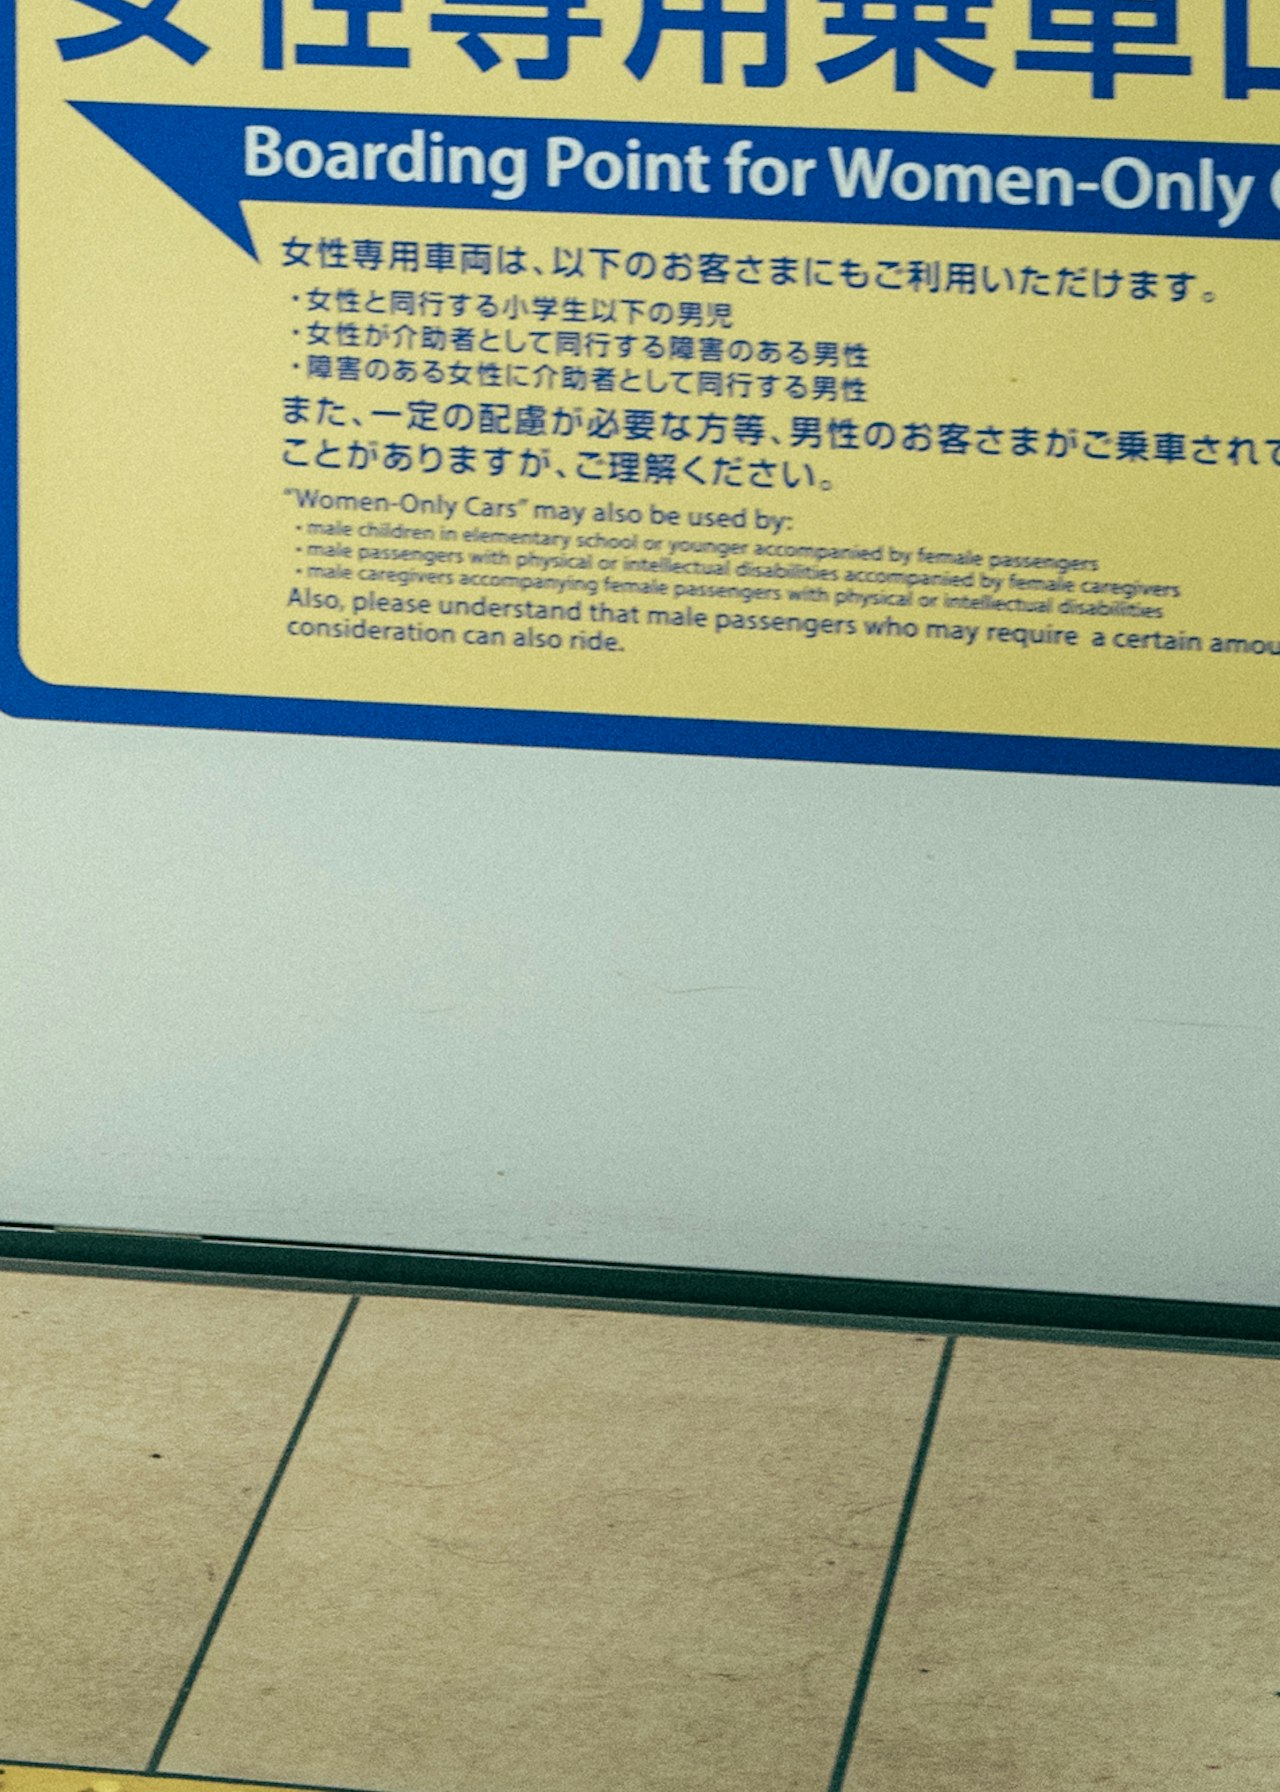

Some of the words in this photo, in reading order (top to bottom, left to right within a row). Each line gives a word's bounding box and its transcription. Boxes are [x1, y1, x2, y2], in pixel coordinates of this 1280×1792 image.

[244, 124, 527, 201] Boarding
[546, 134, 709, 194] Point
[724, 139, 817, 198] for
[827, 146, 1255, 229] Women-Only
[281, 236, 1217, 304] 女性専用車両は、以下のお客さまにもご利用いただけます。
[283, 438, 832, 492] ことがありますが、ご理解ください。
[533, 504, 586, 527] may
[592, 501, 643, 524] also
[649, 504, 681, 526] be
[687, 508, 747, 529] used
[754, 508, 793, 536] by:
[307, 521, 353, 536] male
[358, 522, 435, 540] children
[440, 526, 457, 541] in
[462, 527, 571, 550] elementary
[576, 533, 638, 550] school
[643, 539, 663, 551] or
[668, 540, 749, 559] younger
[753, 544, 884, 564] accompanied
[888, 546, 913, 566] by
[917, 547, 984, 566] female
[989, 555, 1099, 575] passengers
[307, 542, 352, 558] male
[358, 547, 464, 567] passengers
[469, 550, 510, 565] with
[516, 549, 593, 571] physical
[597, 559, 618, 570] or
[623, 555, 730, 576] intellectual
[735, 559, 839, 581] disabilities
[844, 565, 975, 587] accompanied
[980, 568, 1004, 589] by
[1008, 571, 1075, 589] female
[1080, 581, 1181, 601] caregivers
[287, 587, 345, 612] Also,
[352, 590, 432, 620] please
[438, 596, 582, 622] understand
[588, 602, 640, 624] that
[647, 606, 708, 628] male
[715, 605, 857, 638] passengers
[863, 615, 919, 638] who
[926, 623, 980, 645] may
[986, 624, 1079, 648] require
[1091, 631, 1106, 647] a
[1112, 630, 1203, 651] certain
[307, 564, 353, 580] male
[357, 565, 454, 587] caregivers
[459, 570, 599, 594] accompanying
[603, 576, 669, 595] female
[673, 578, 782, 603] passengers
[787, 587, 829, 602] with
[834, 584, 913, 608] physical
[918, 595, 938, 608] or
[943, 594, 1053, 613] intellectual
[1057, 599, 1164, 619] disabilities
[287, 618, 456, 643] consideration
[463, 629, 506, 646] can
[512, 626, 563, 649] also
[569, 630, 625, 652] ride.
